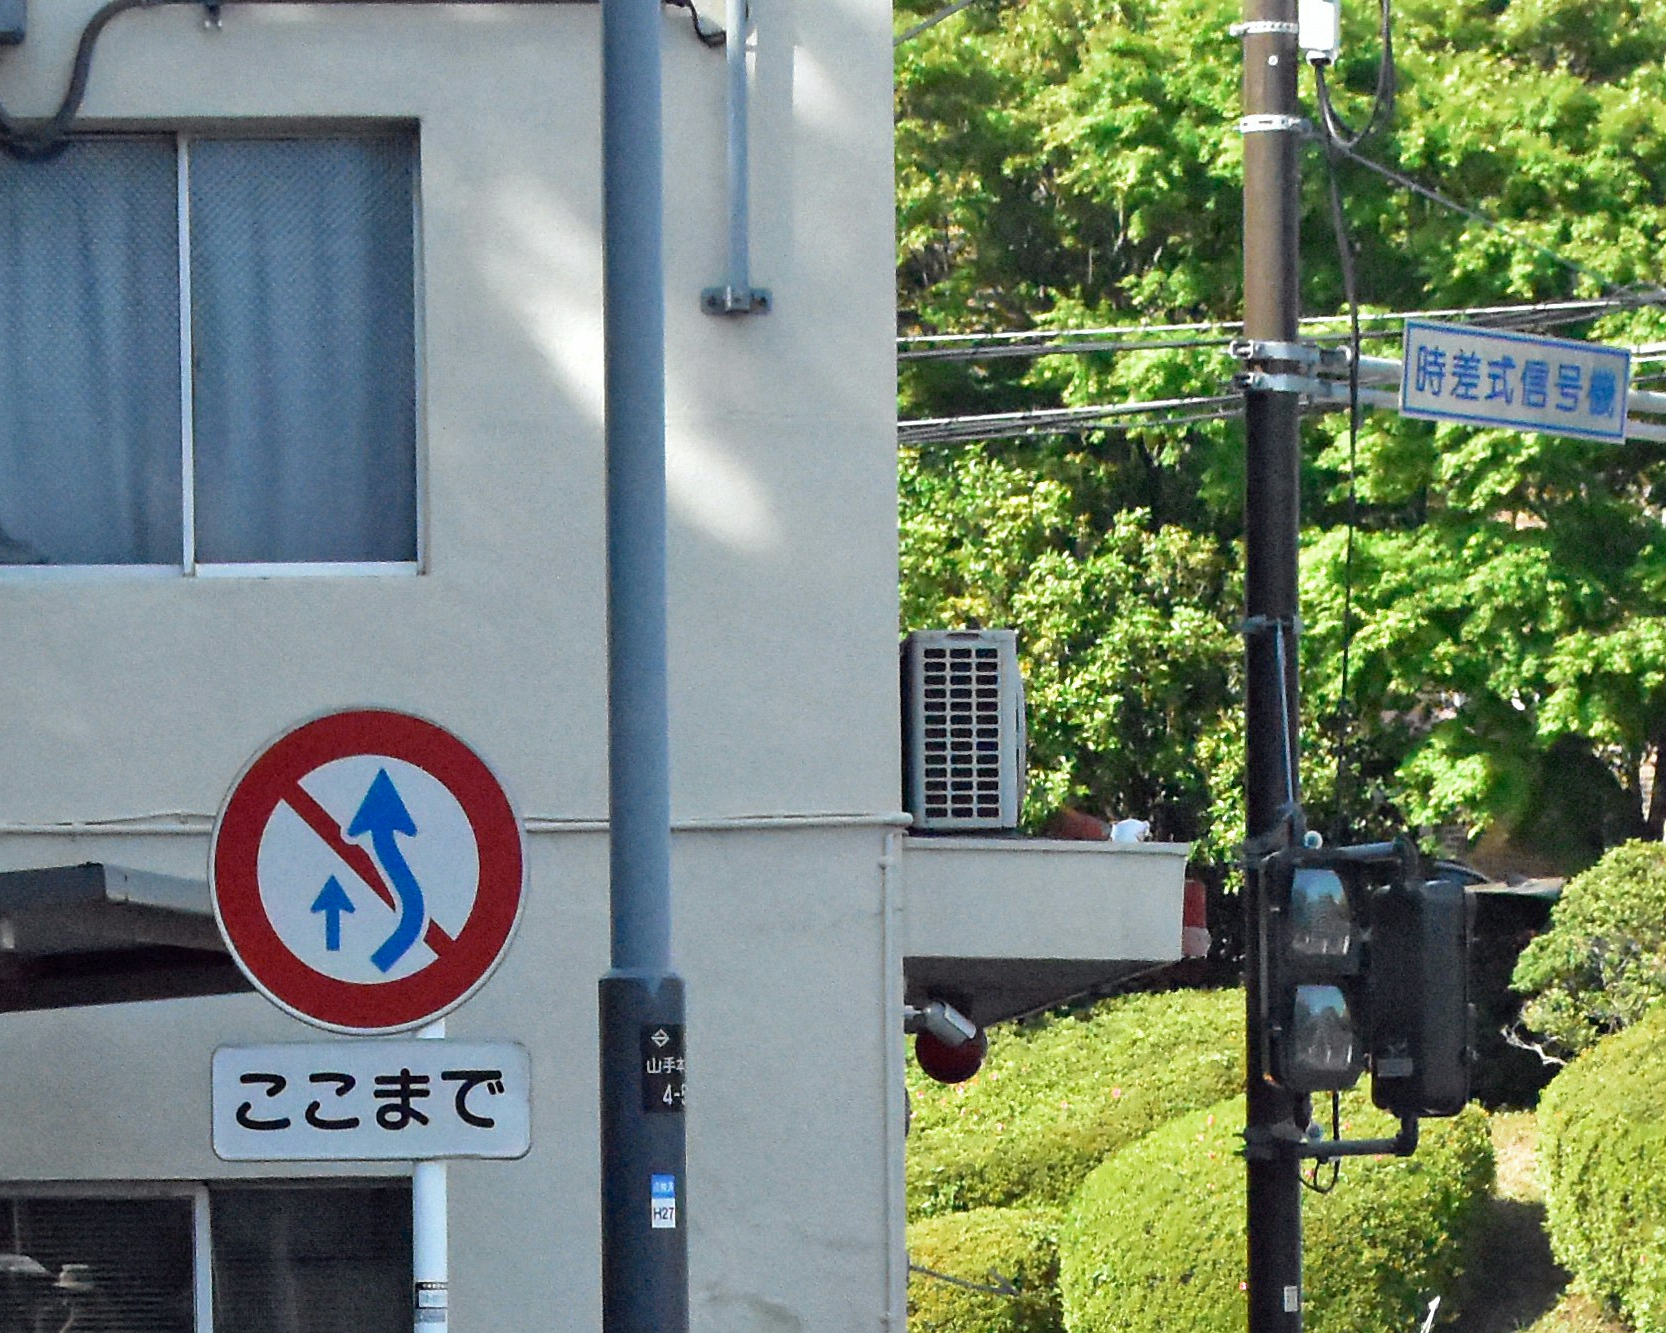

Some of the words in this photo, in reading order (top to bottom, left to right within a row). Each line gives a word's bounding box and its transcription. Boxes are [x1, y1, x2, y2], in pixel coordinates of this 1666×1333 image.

[235, 1068, 505, 1130] ここまで
[654, 1206, 674, 1221] H27
